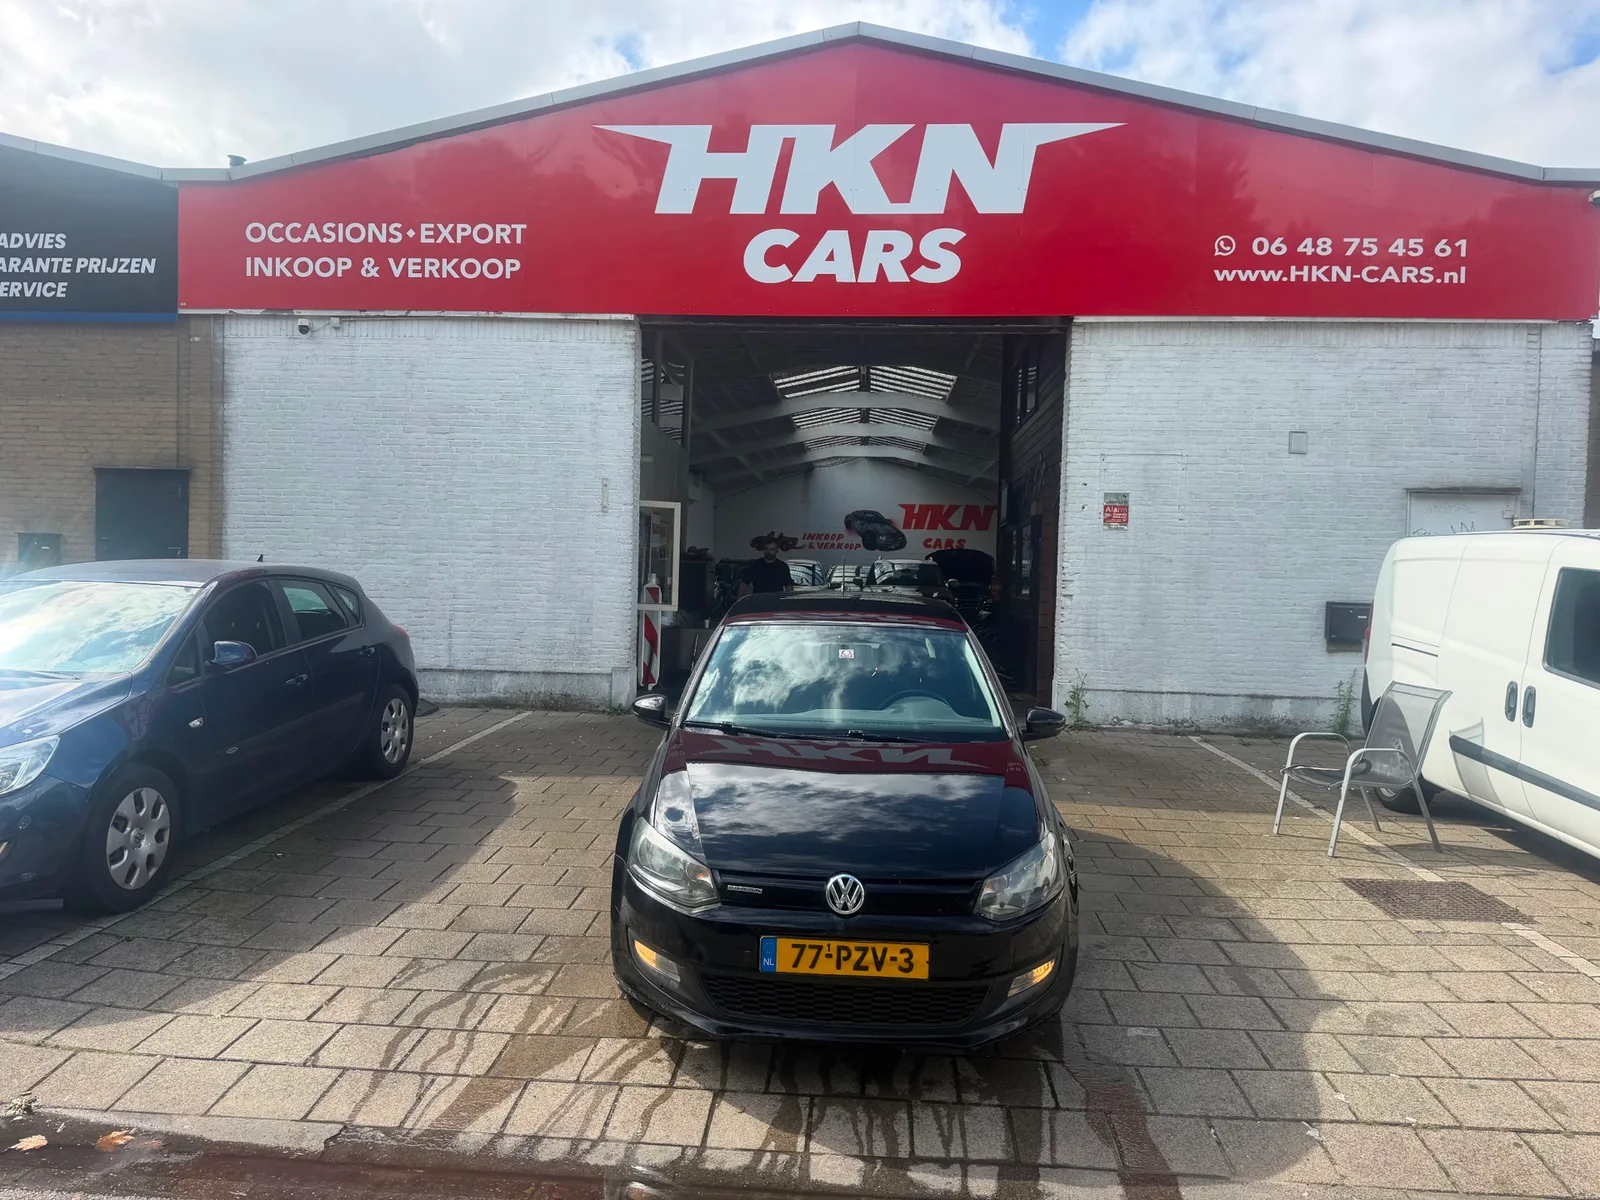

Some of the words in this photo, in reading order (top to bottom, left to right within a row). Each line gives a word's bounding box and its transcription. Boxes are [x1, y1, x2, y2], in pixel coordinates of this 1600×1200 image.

[592, 123, 1128, 214] HKN
[245, 222, 402, 243] OCCASIONS
[419, 223, 527, 244] EXPORT
[743, 228, 967, 283] CARS
[1251, 237, 1287, 256] 06
[1296, 237, 1333, 256] 48
[1343, 238, 1378, 256] 75
[1388, 238, 1424, 257] 45
[1434, 239, 1468, 258] 61
[75, 257, 157, 274] PRIJZEN
[245, 256, 352, 278] INKOOP
[360, 257, 380, 278] &
[388, 257, 521, 279] VERKOOP
[1213, 265, 1466, 284] www.HKN-CARS.nl
[897, 503, 998, 531] HKN
[802, 532, 844, 541] INKOOP
[817, 541, 862, 551] VERKOOP
[923, 537, 967, 550] CARS
[763, 958, 775, 967] NL
